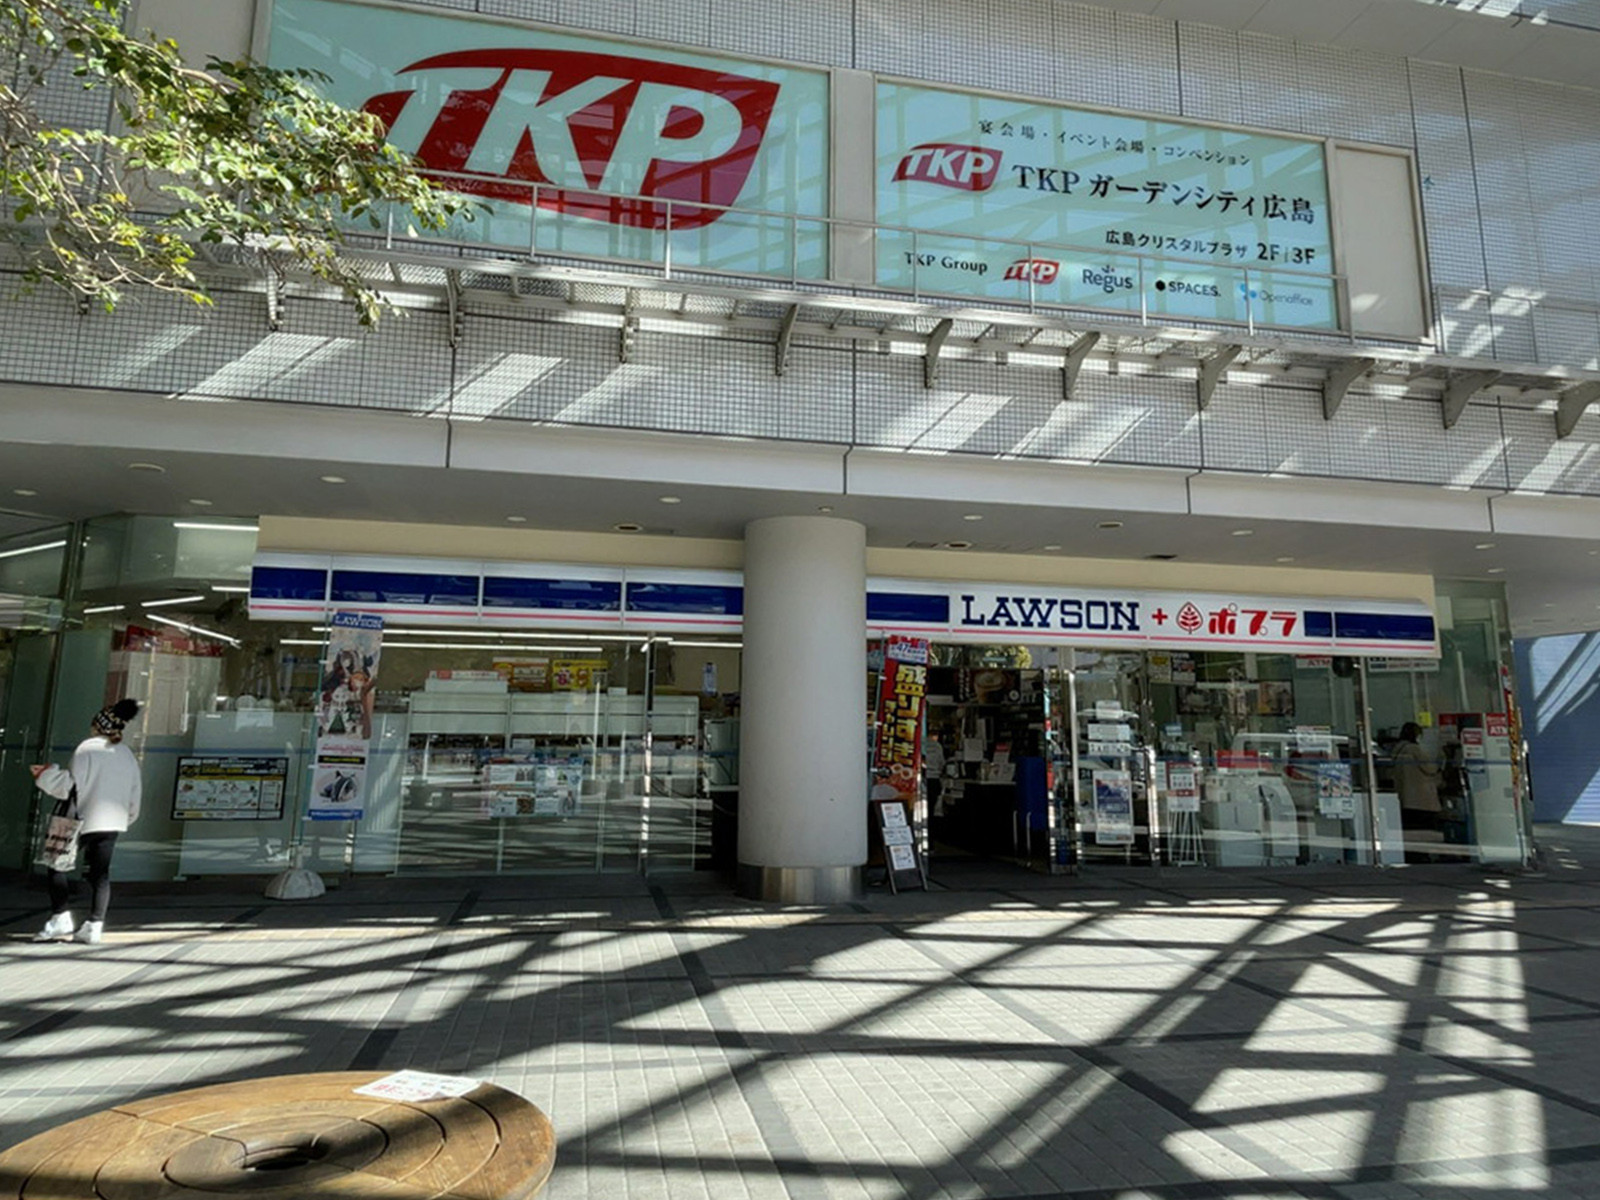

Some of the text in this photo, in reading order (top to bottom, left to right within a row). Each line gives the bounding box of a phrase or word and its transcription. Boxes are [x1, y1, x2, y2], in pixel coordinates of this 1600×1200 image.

[385, 68, 743, 198] TKP
[904, 148, 995, 184] TKP
[1011, 164, 1315, 225] TKP ガーデンシティ広島
[1105, 229, 1248, 259] 広島クリスタルプラザ
[904, 251, 989, 276] TKP Group
[1007, 261, 1056, 281] TKP
[1082, 267, 1134, 293] Regus
[961, 595, 1141, 632] LAWSON
[1208, 602, 1298, 638] ポプラ
